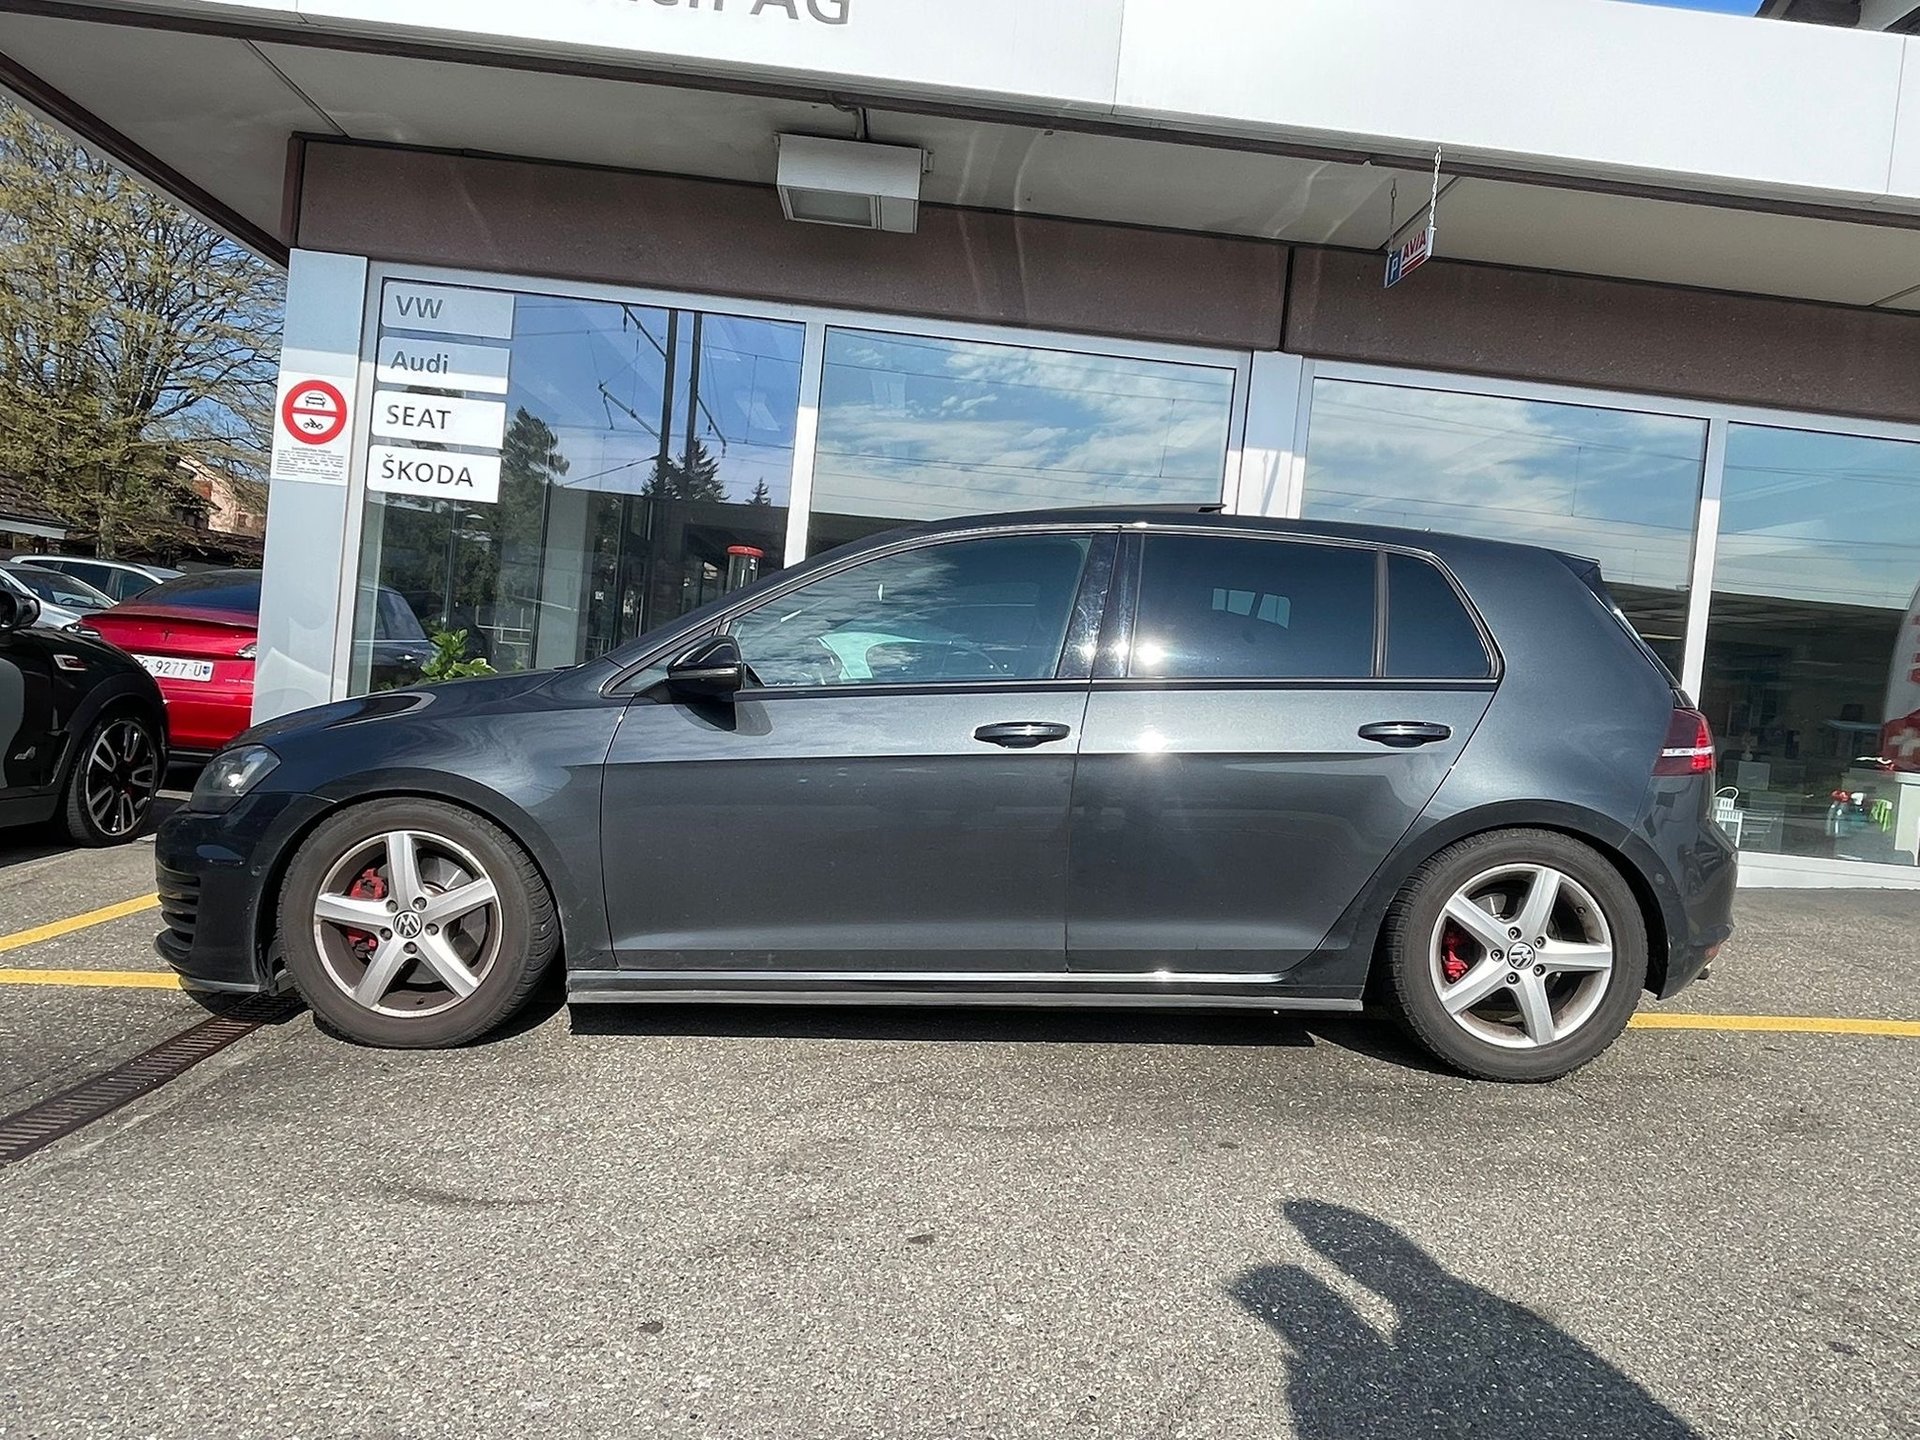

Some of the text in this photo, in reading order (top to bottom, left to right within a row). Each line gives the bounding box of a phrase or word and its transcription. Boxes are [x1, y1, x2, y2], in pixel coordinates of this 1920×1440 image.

[1403, 230, 1426, 259] AVIA
[396, 295, 443, 319] VW
[390, 351, 449, 374] Audi
[386, 404, 451, 430] SEAT
[381, 453, 473, 487] ŠKODA
